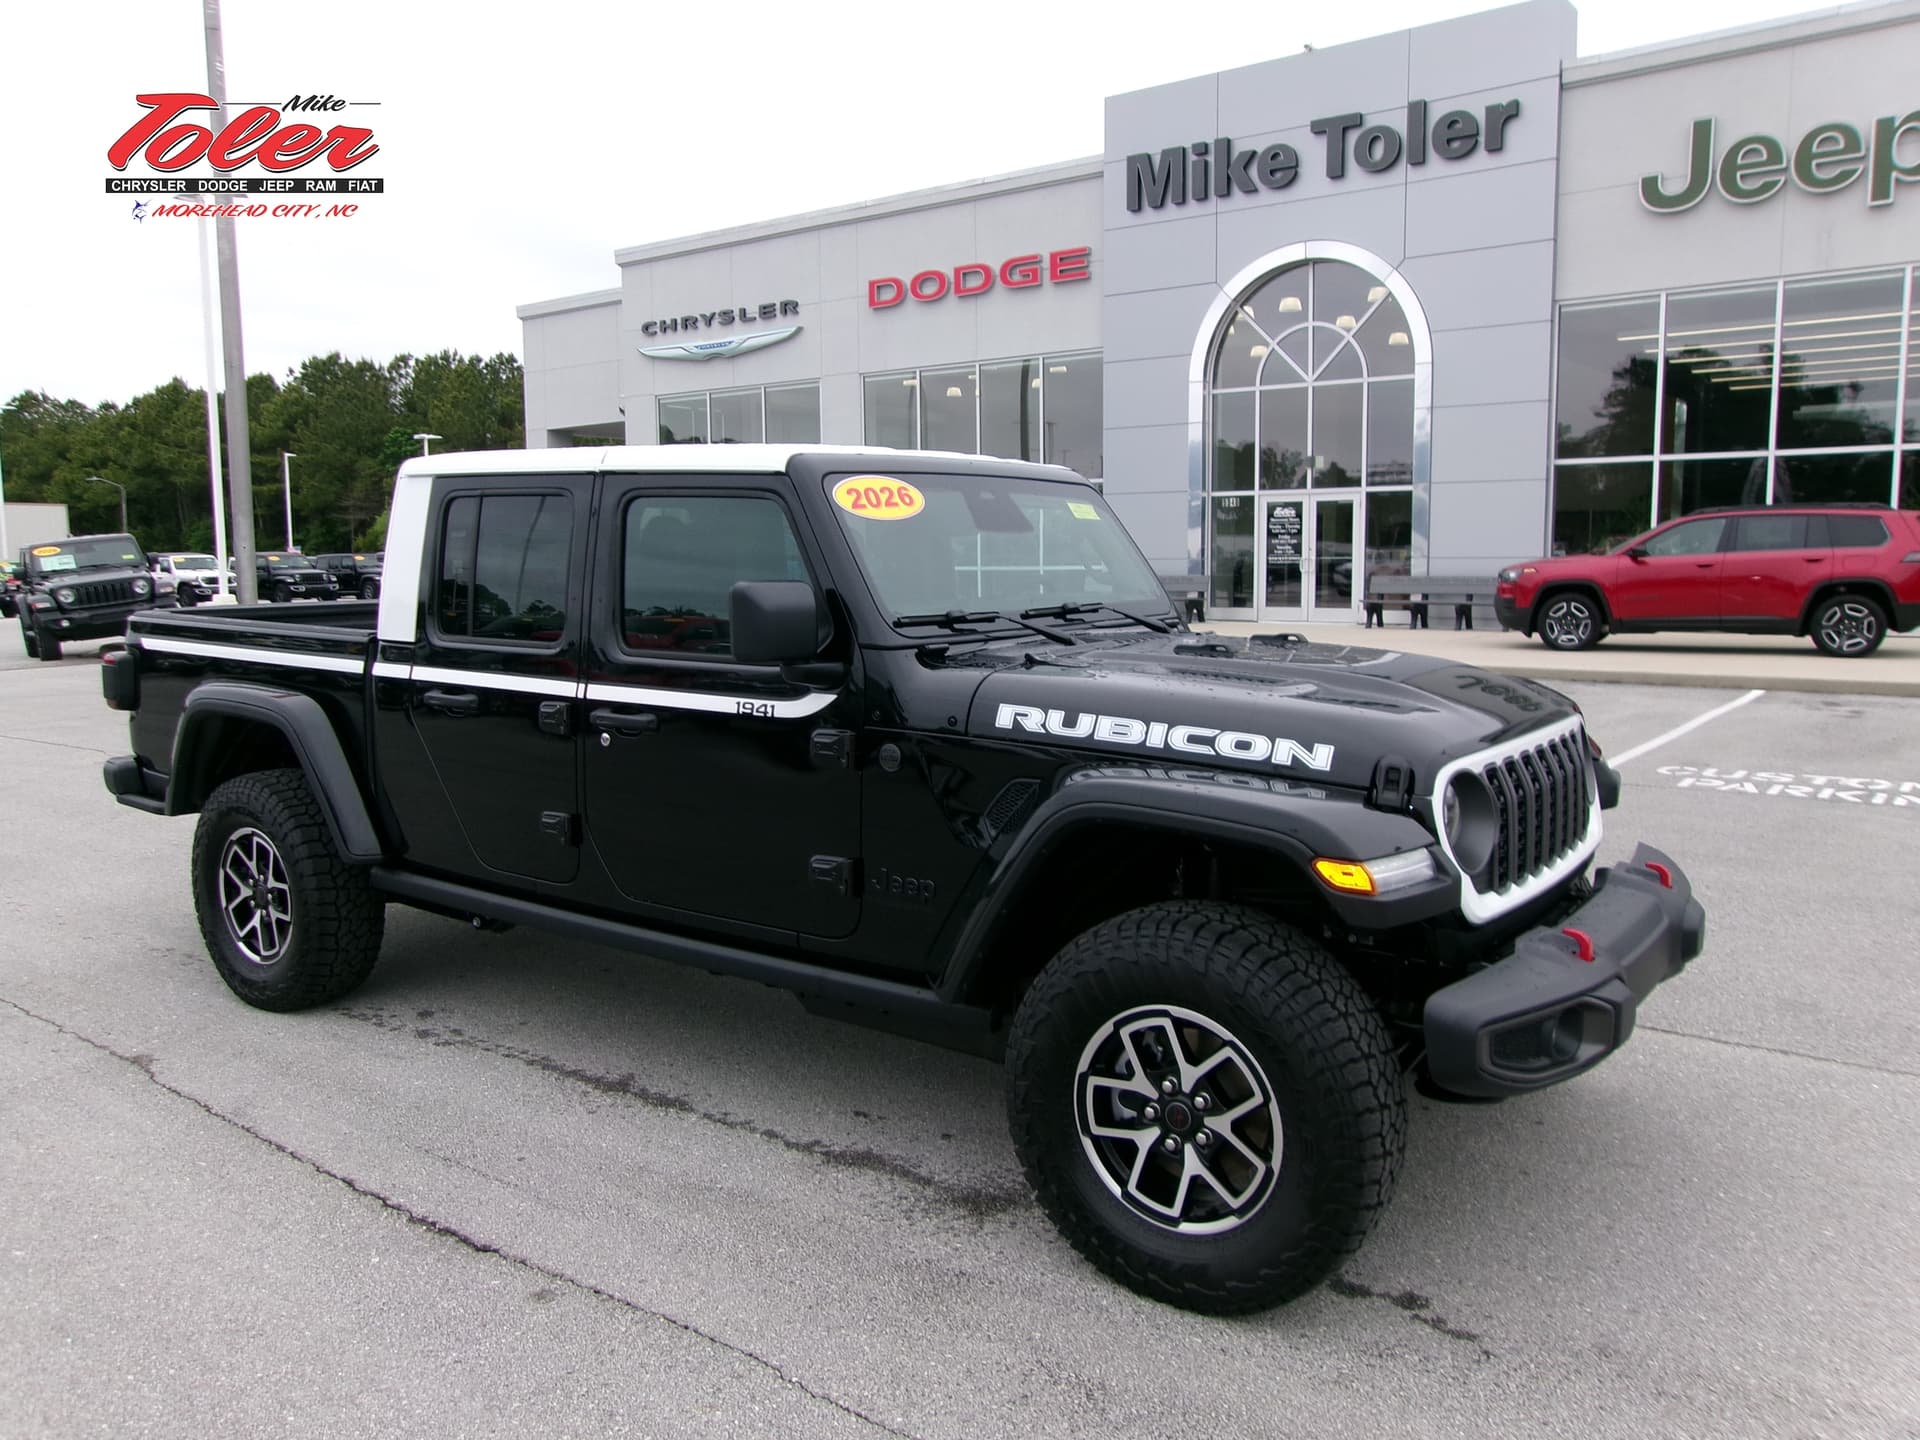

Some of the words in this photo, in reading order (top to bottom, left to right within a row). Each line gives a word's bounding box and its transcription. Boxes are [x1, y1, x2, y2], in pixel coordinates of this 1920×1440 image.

[1126, 136, 1300, 212] Mike
[1310, 98, 1521, 180] Toler
[1639, 108, 1920, 213] Jeep
[867, 246, 1092, 310] DODGE
[641, 299, 801, 337] CHRYSLER
[846, 485, 916, 511] 2026
[735, 700, 776, 718] 1941
[995, 703, 1336, 772] RUBICON
[870, 867, 937, 904] Jeep
